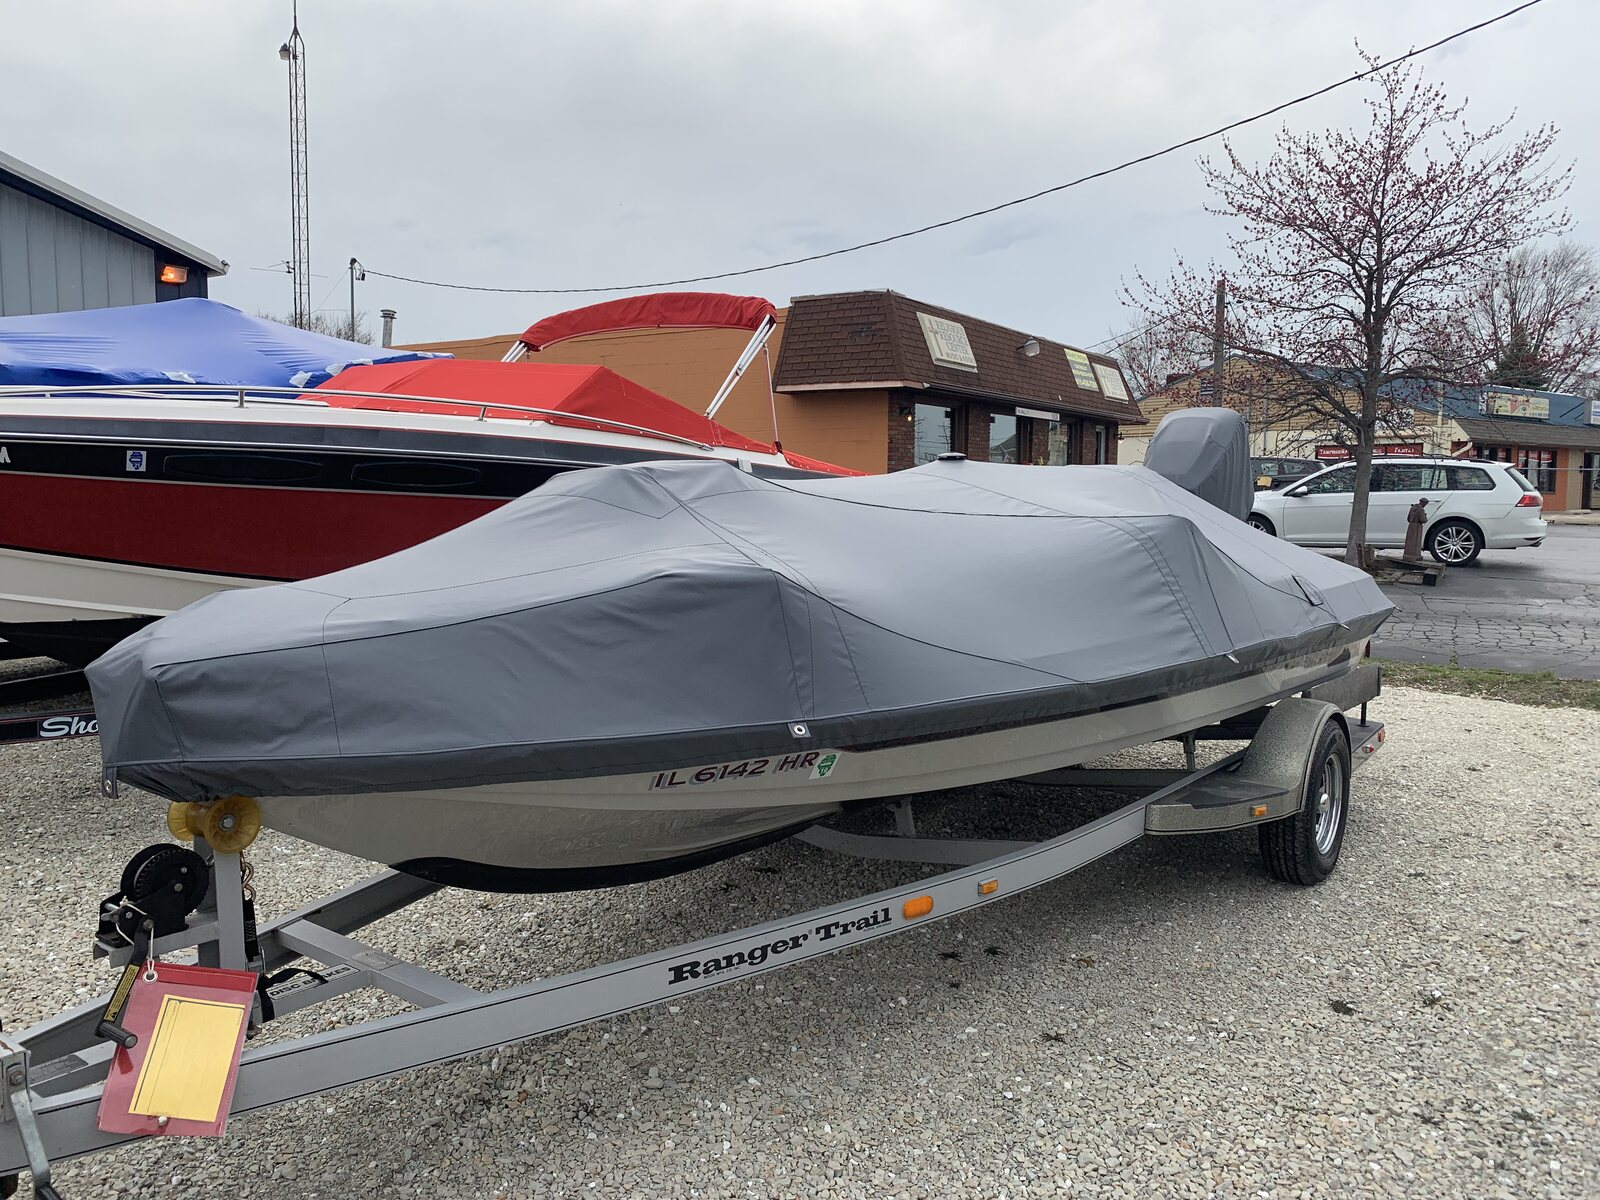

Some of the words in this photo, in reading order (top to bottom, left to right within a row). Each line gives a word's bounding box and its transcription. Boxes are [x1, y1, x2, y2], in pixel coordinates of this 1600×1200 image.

[651, 771, 686, 790] IL
[692, 759, 770, 784] 6142
[775, 751, 820, 774] HR
[815, 907, 893, 942] Trail
[269, 982, 301, 997] DISC
